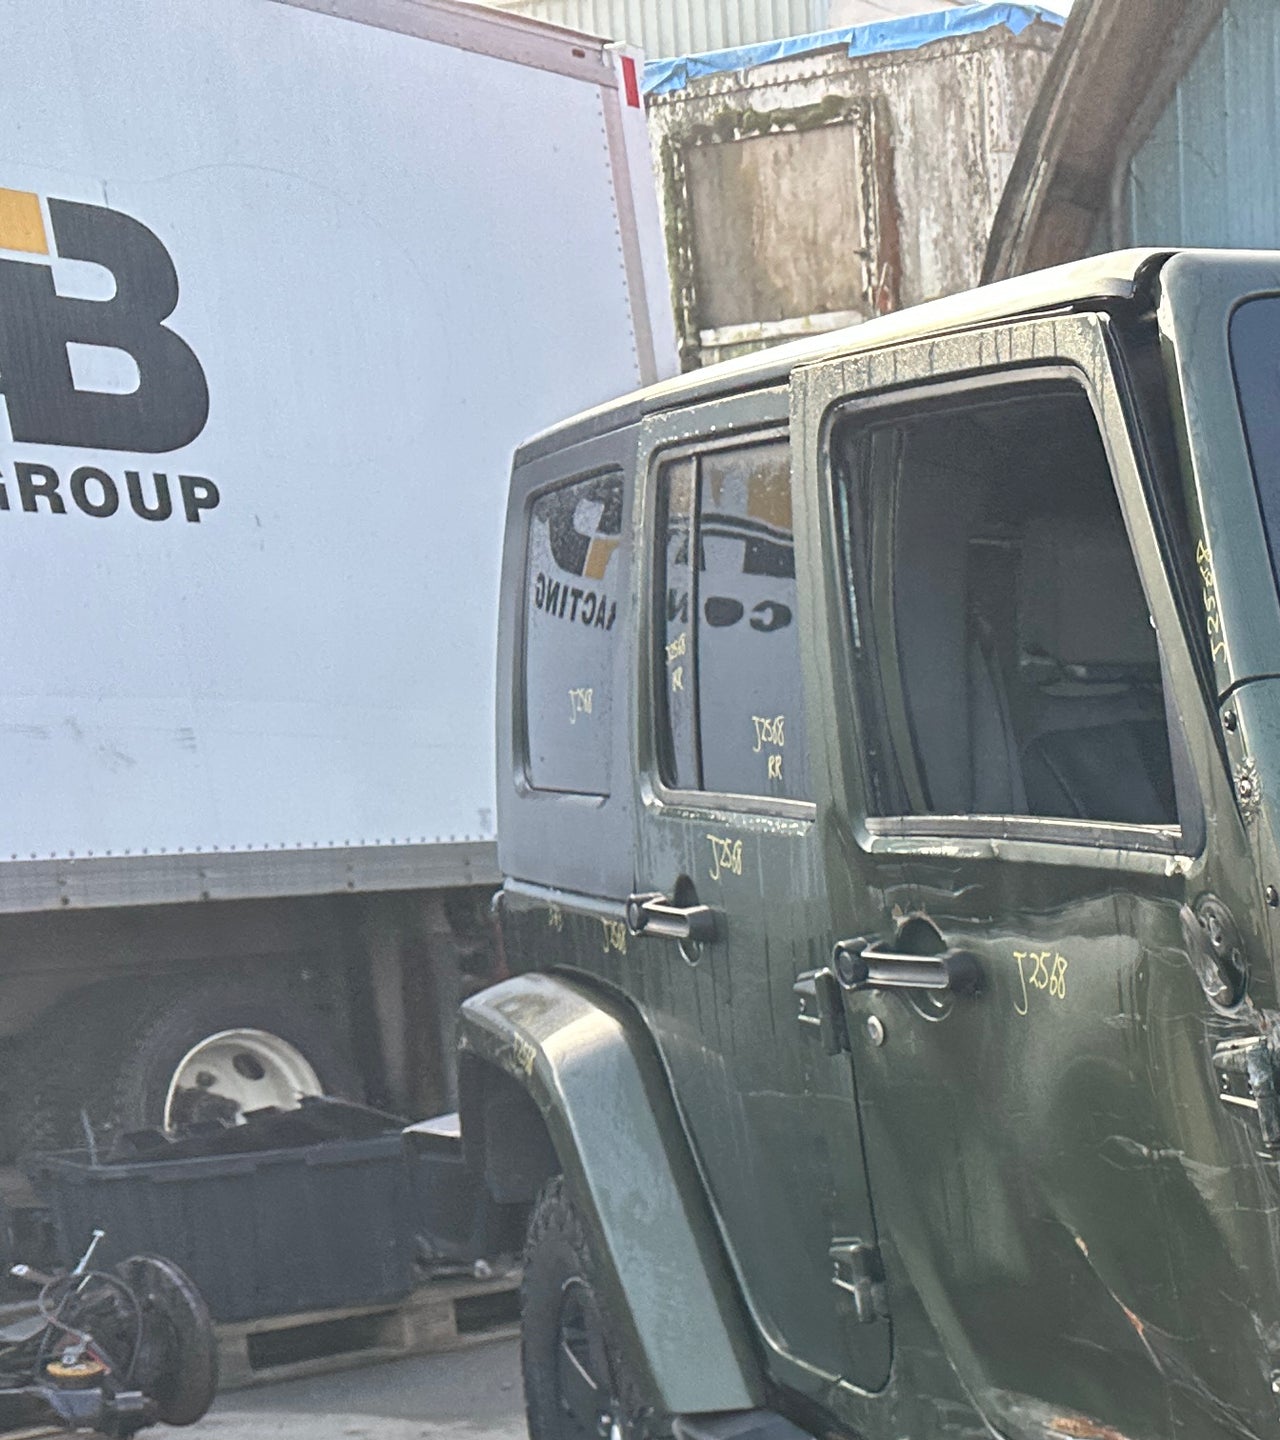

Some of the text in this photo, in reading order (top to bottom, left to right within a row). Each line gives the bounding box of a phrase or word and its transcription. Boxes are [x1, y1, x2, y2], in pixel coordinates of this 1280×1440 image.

[0, 461, 220, 523] ROUP
[752, 715, 785, 752] J2568
[1013, 951, 1068, 1016] J2568
